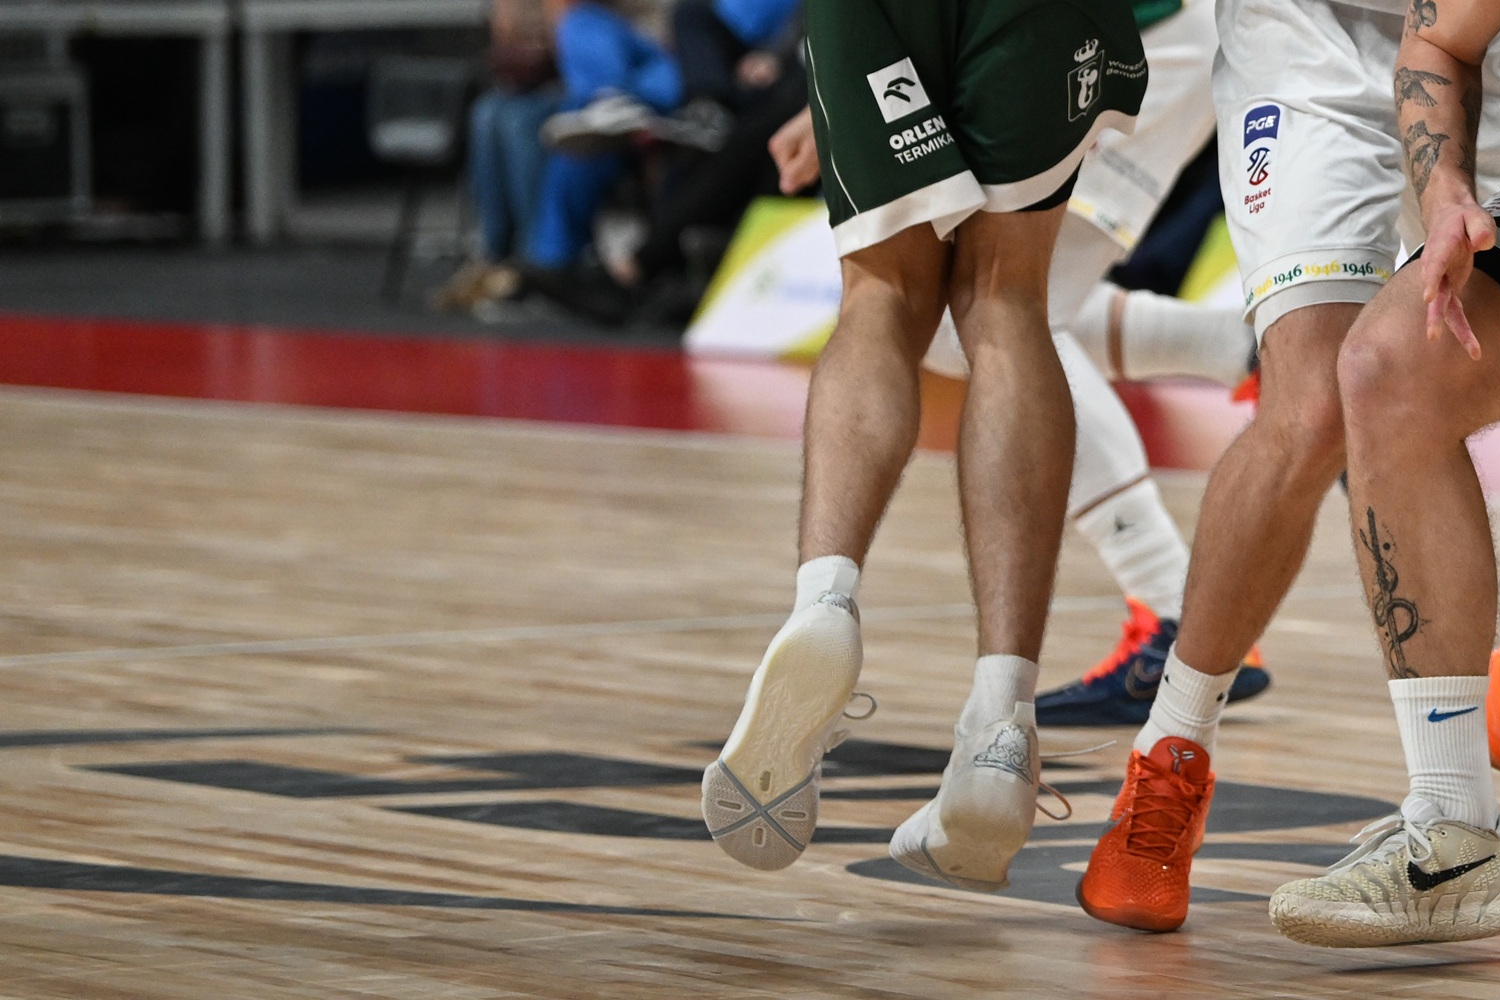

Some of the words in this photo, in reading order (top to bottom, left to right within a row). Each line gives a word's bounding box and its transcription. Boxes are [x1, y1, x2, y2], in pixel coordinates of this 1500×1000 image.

[889, 114, 946, 150] ORLEN
[1246, 115, 1276, 135] PGE
[894, 132, 955, 165] TERMIKA
[1244, 187, 1271, 205] Basket
[1249, 201, 1265, 214] Liga
[1273, 263, 1303, 286] 1946
[1304, 259, 1341, 277] 1946
[1342, 261, 1374, 277] 1946
